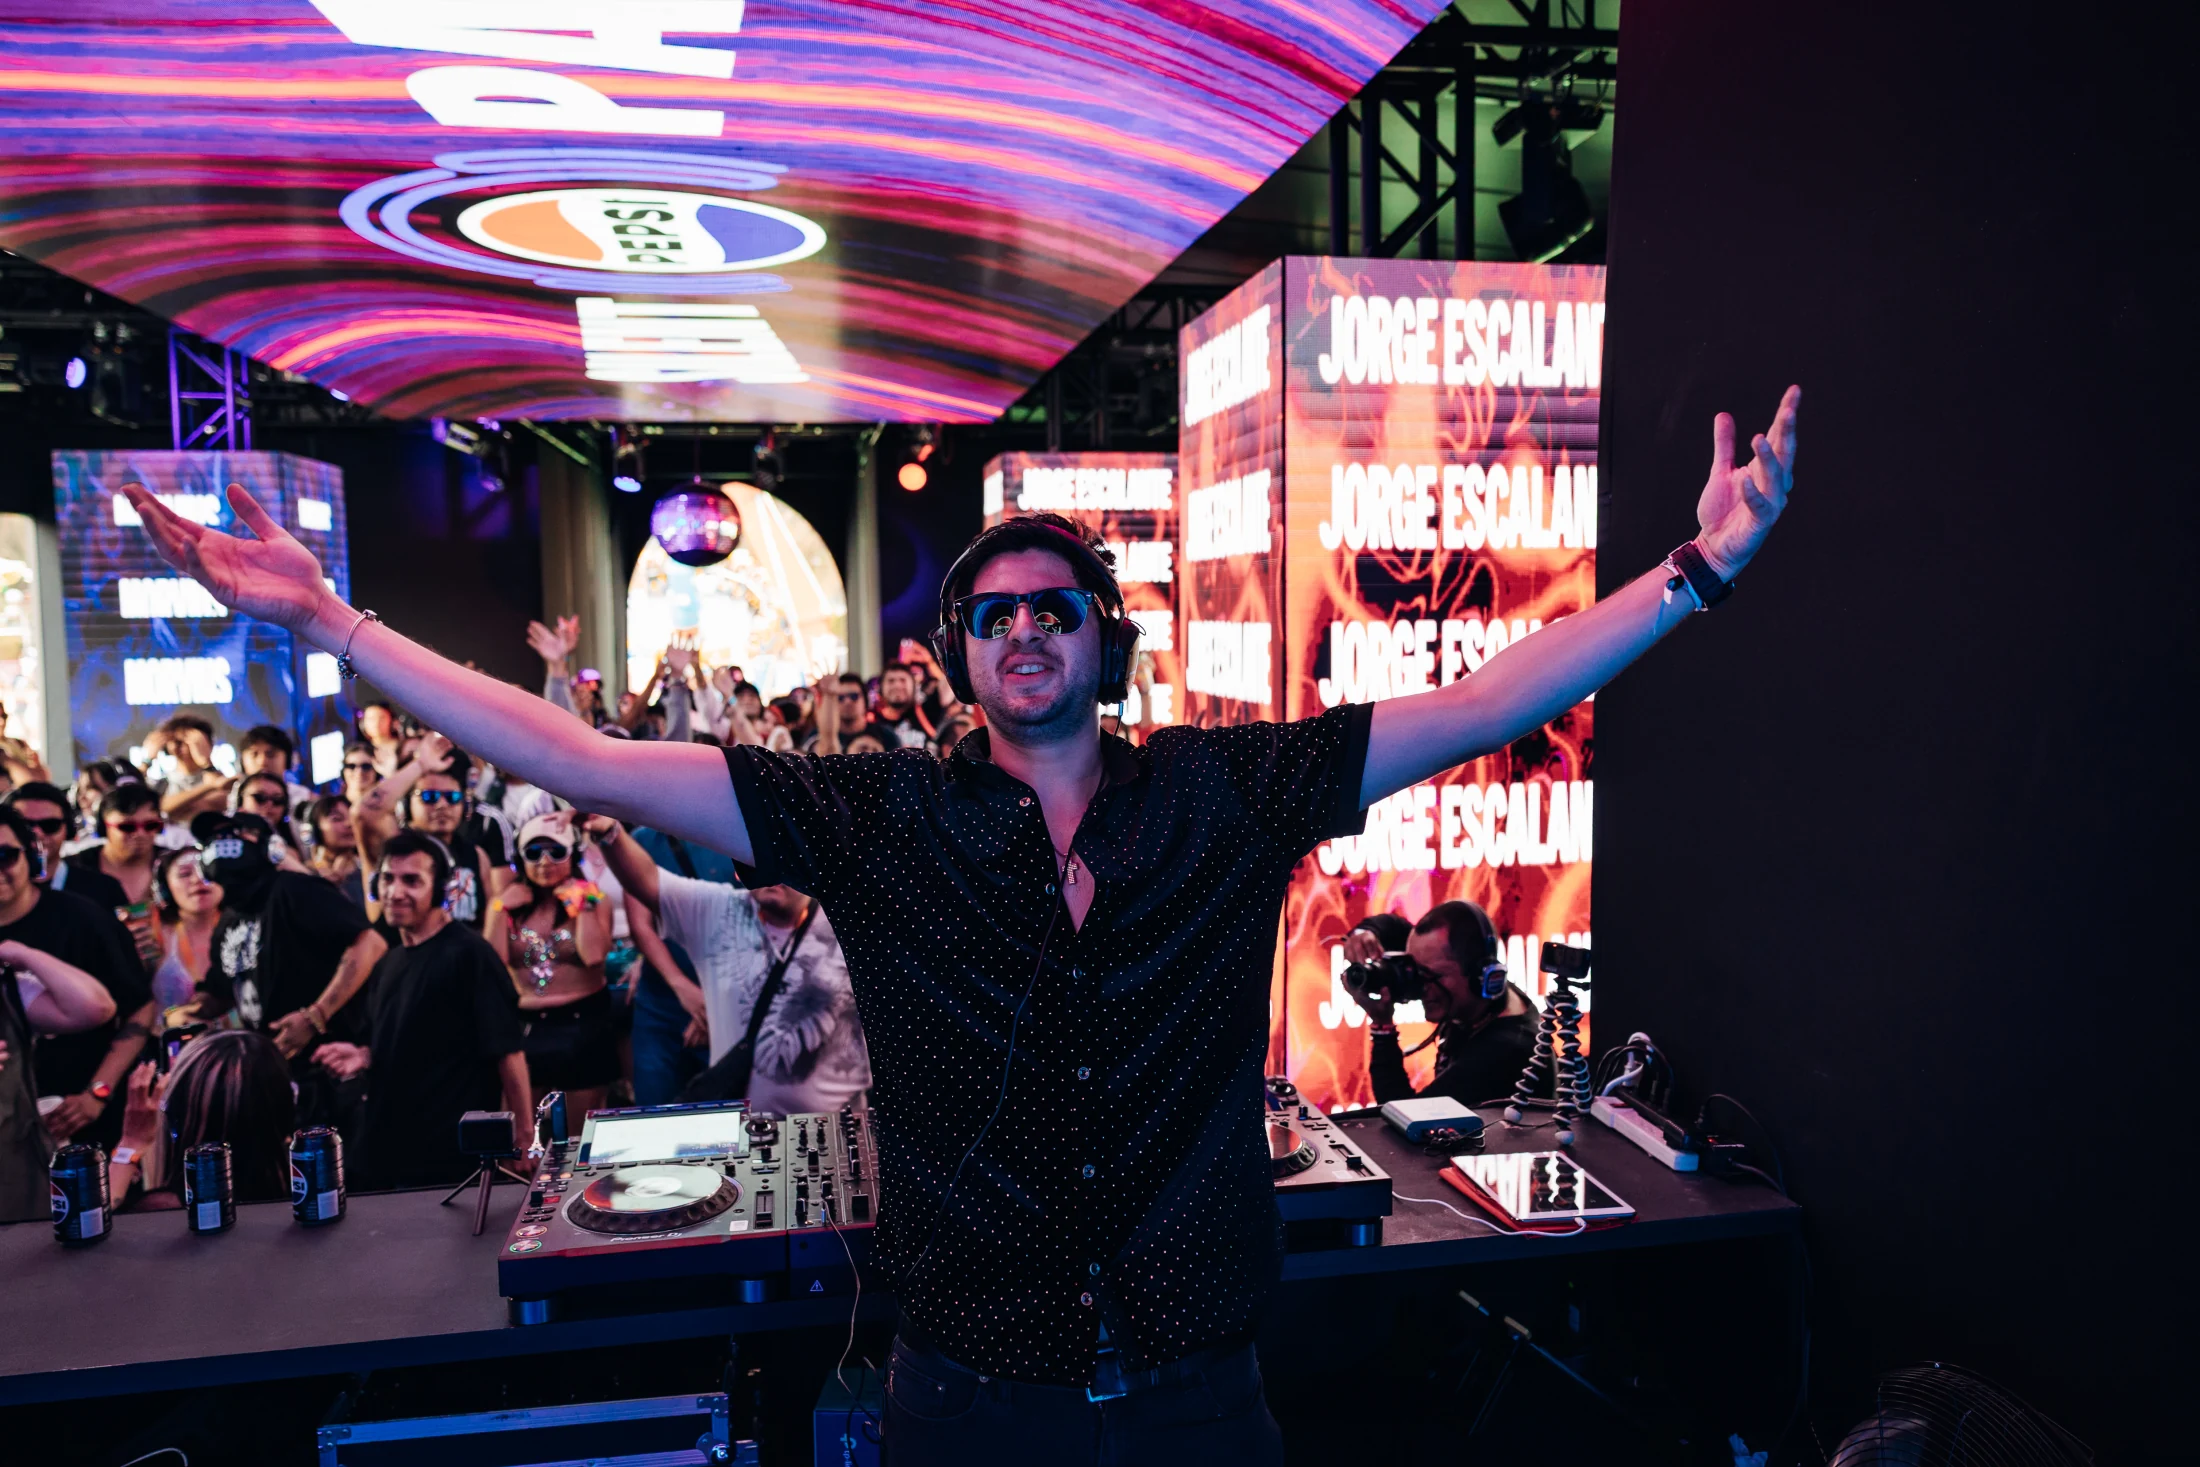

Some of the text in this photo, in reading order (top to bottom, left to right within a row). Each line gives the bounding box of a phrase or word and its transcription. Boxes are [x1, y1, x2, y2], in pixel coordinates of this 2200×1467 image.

[602, 199, 688, 265] PEPSI
[1318, 295, 1438, 386] JORGE
[1318, 463, 1438, 550] JORGE
[1318, 619, 1437, 708] JORGE
